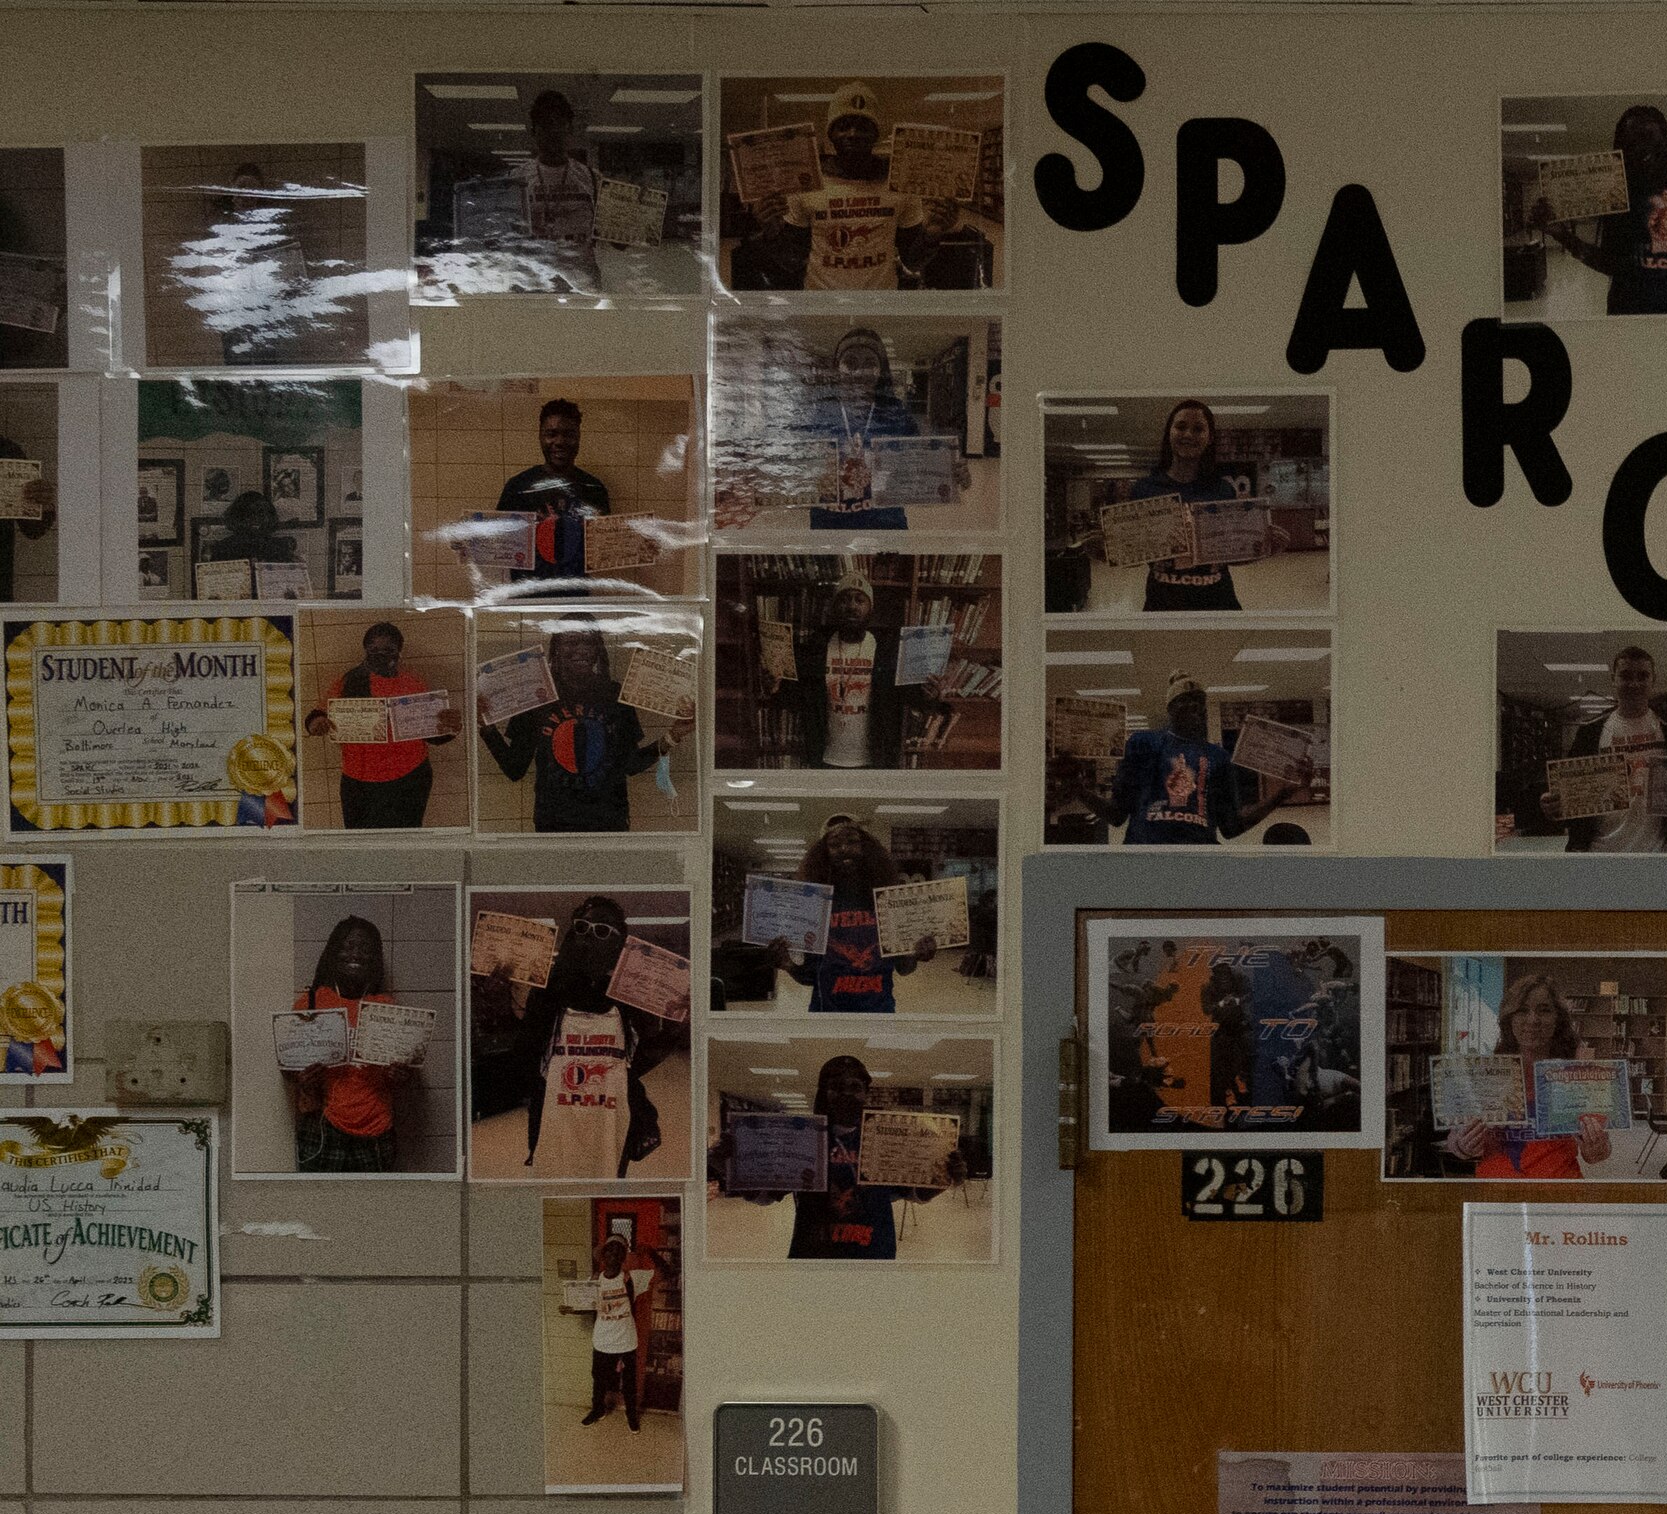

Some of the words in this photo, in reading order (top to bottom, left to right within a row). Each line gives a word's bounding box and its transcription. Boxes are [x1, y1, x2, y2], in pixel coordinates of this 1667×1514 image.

[42, 653, 138, 681] STUDENT
[173, 652, 258, 679] MONTH
[74, 696, 124, 712] Monica
[142, 697, 151, 711] A
[162, 721, 187, 737] High
[1183, 945, 1280, 969] THE
[1133, 1022, 1219, 1038] ROAD
[1258, 1018, 1318, 1041] TO
[1151, 1104, 1305, 1125] STATES!
[35, 1151, 91, 1166] CERTIFIES
[1191, 1156, 1306, 1217] 226
[28, 1199, 51, 1213] US
[63, 1200, 106, 1216] History
[71, 1217, 199, 1264] ACHIEVEMENT
[1526, 1231, 1555, 1245] Mr.
[1562, 1231, 1629, 1246] Rollins
[1548, 1269, 1593, 1278] University
[1567, 1282, 1597, 1292] History
[1490, 1371, 1553, 1395] WCU
[1597, 1380, 1628, 1391] University
[1636, 1381, 1659, 1390] Phoenix
[1477, 1394, 1510, 1406] WEST
[1512, 1394, 1569, 1406] CHESTER
[1477, 1406, 1570, 1417] UNIVERSITY
[768, 1416, 824, 1448] 226
[734, 1455, 859, 1478] CLASSROOM
[1511, 1454, 1530, 1466] part
[1543, 1454, 1574, 1464] college
